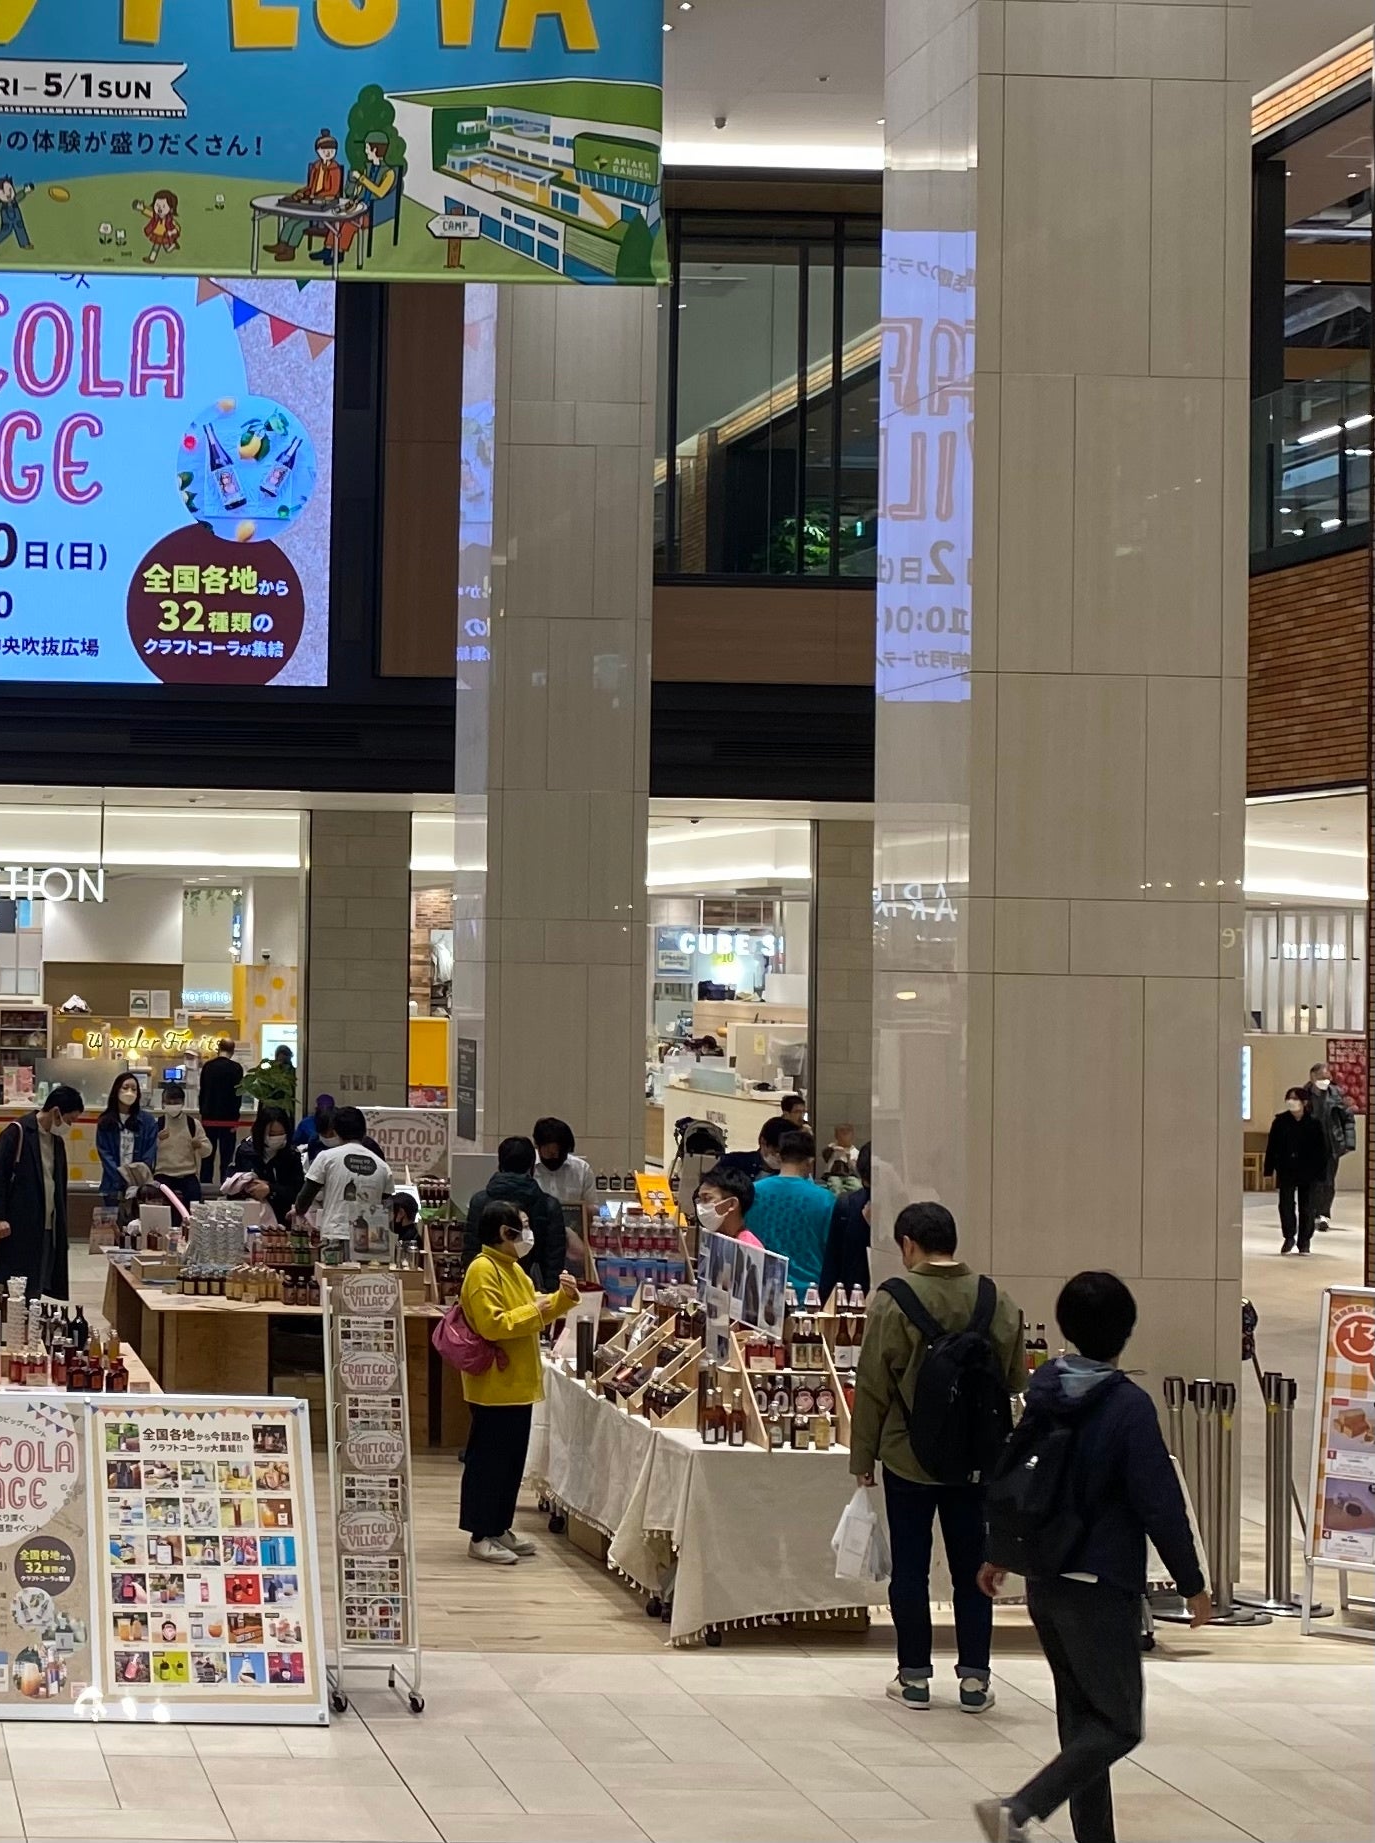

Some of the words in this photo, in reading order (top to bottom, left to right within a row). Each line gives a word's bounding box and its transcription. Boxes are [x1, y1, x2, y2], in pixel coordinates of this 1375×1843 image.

[43, 73, 93, 98] 5/1
[98, 80, 152, 99] SUN
[442, 220, 469, 231] CAMP
[142, 563, 289, 596] 全国各地から
[157, 600, 274, 633] 32種類の
[143, 638, 285, 658] クラフトコーラが集結
[679, 933, 750, 956] CUBE
[406, 1127, 445, 1146] COLA
[343, 1284, 372, 1298] CRAFT
[373, 1284, 396, 1297] COLA
[350, 1296, 389, 1308] VILLAGE
[341, 1362, 371, 1375] CRAFT
[372, 1363, 396, 1375] COLA
[349, 1373, 389, 1386] VILLAGE
[348, 1441, 378, 1454] CRAFT
[380, 1441, 403, 1453] COLA
[357, 1453, 396, 1466] VILLAGE
[340, 1523, 370, 1537] CRAFT
[371, 1522, 395, 1535] COLA
[348, 1534, 389, 1548] VILLAGE
